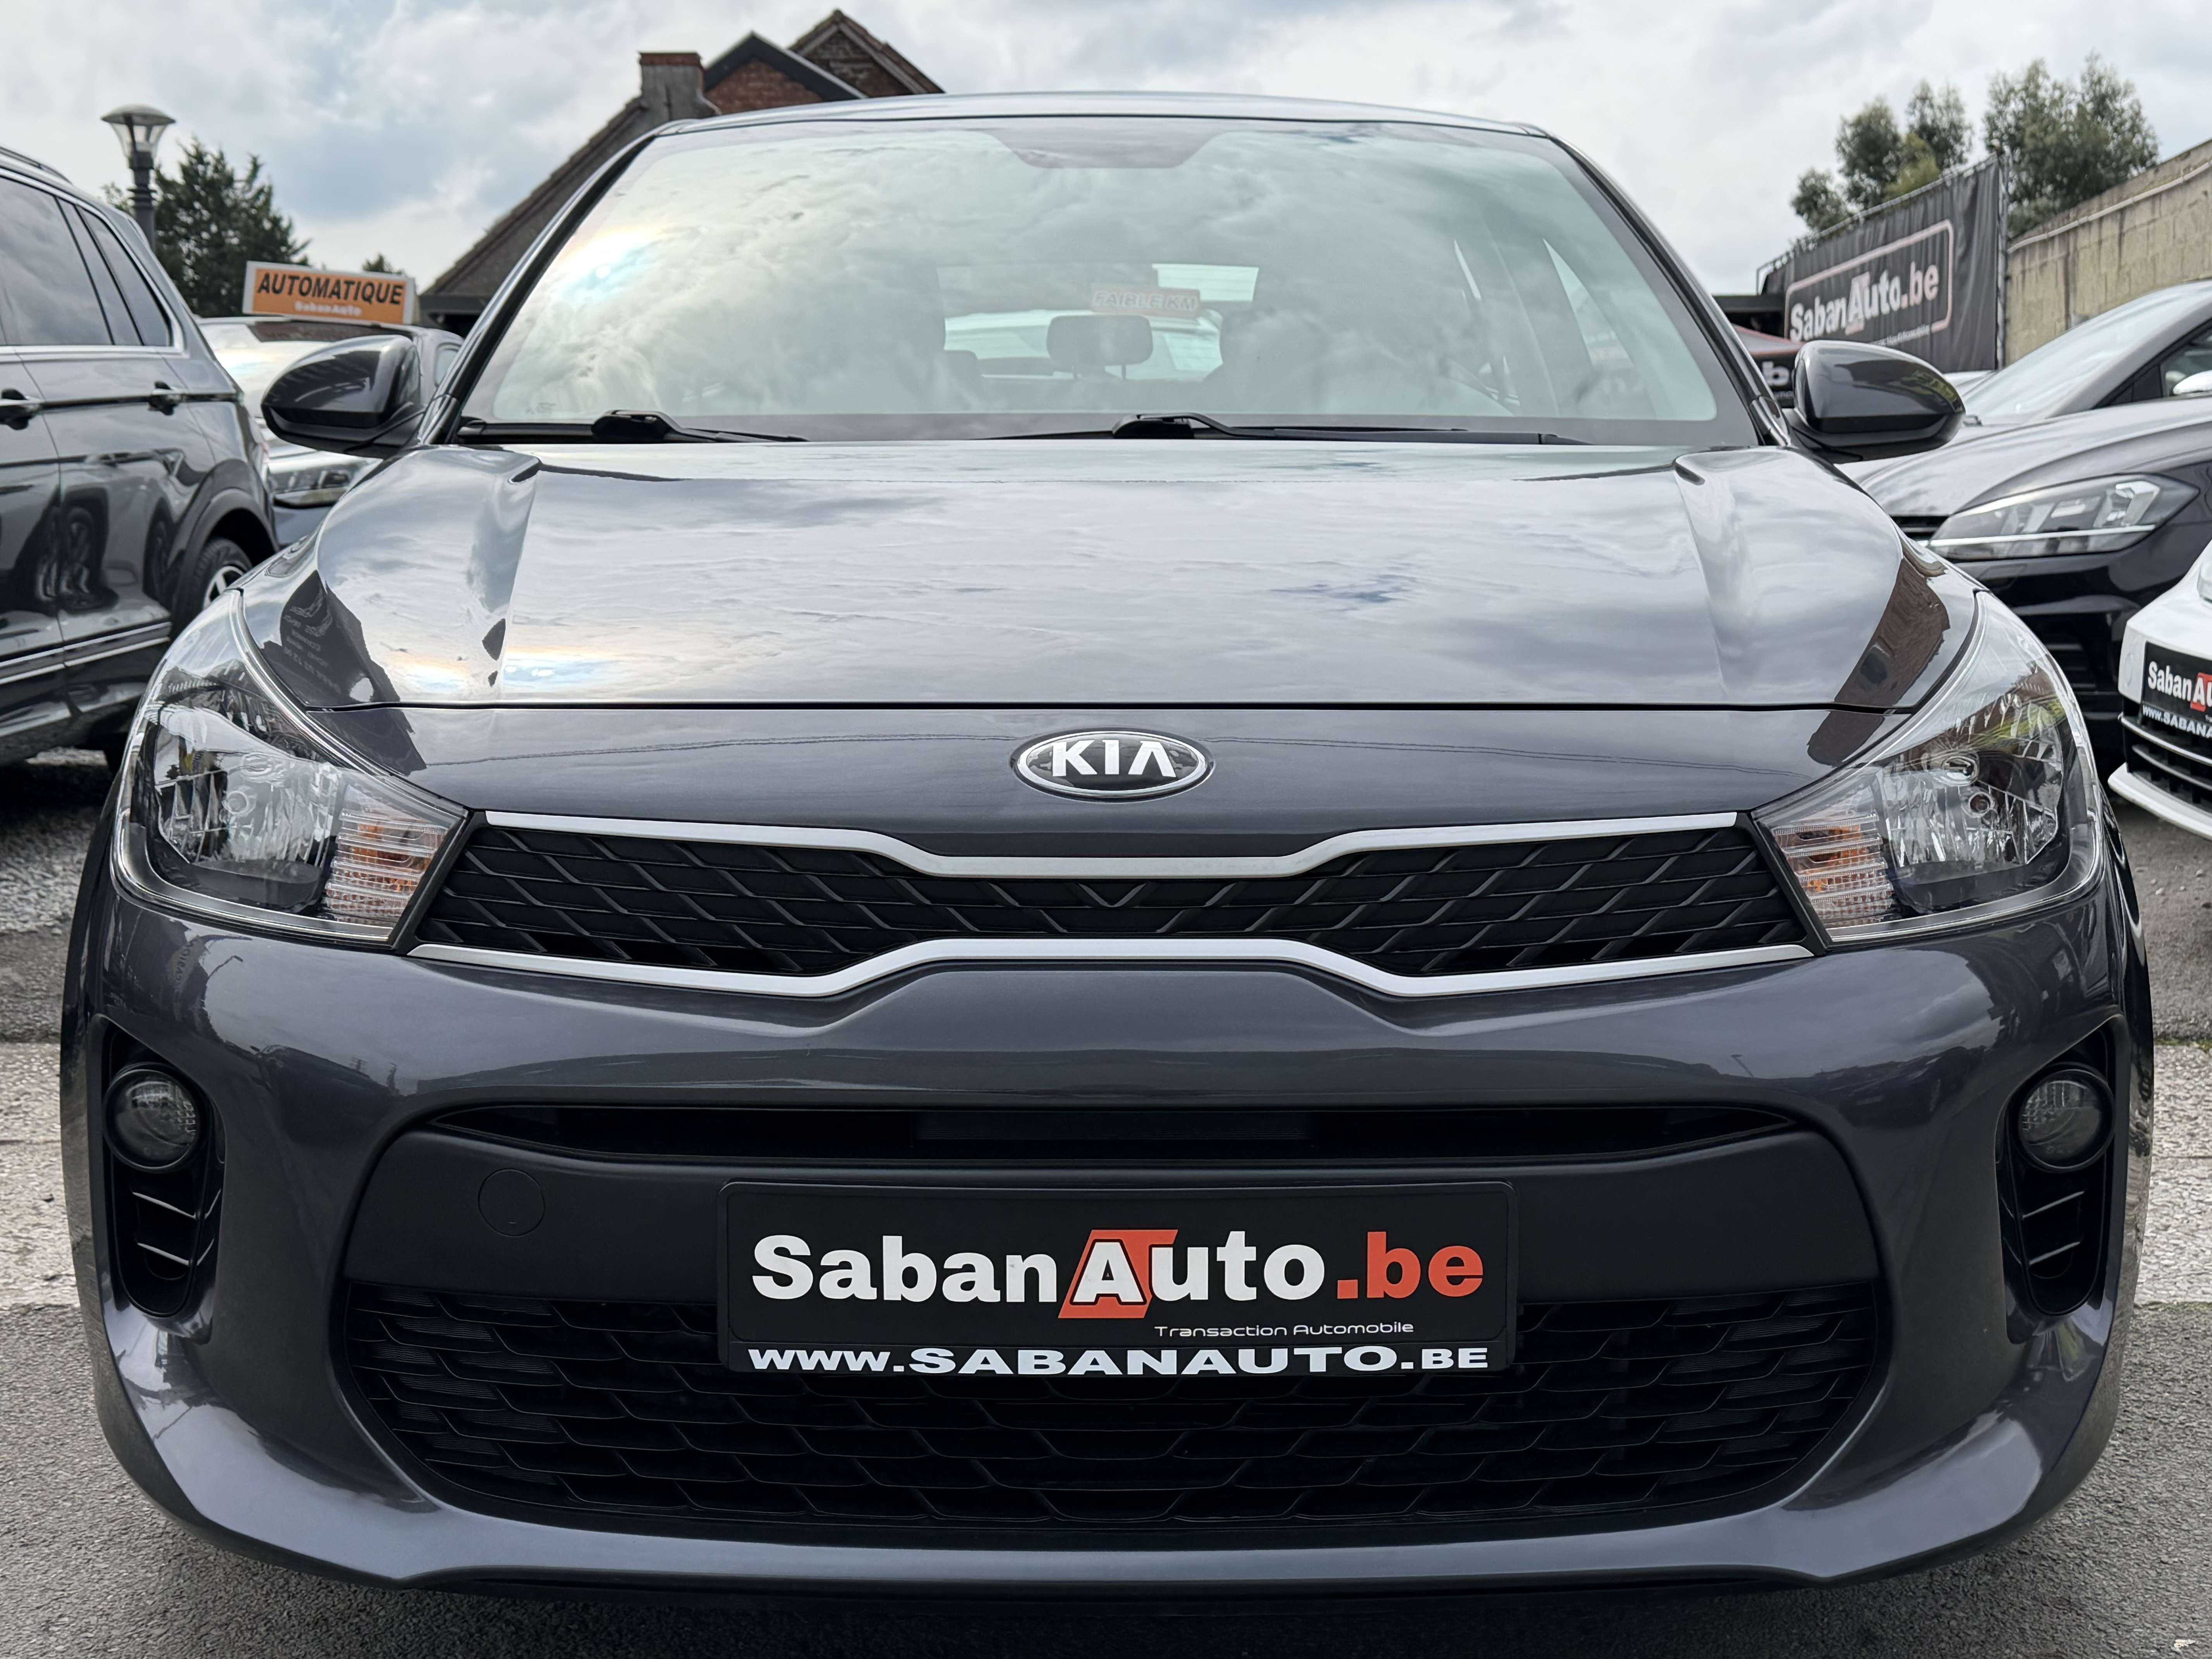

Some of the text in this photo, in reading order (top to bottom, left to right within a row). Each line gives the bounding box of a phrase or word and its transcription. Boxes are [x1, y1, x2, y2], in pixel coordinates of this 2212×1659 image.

[257, 272, 404, 305] AUTOMATIQUE
[1093, 290, 1198, 310] FAIBLE KM
[1790, 261, 1939, 342] SabanAuto.be
[1052, 739, 1176, 778] KIA
[1154, 1322, 1414, 1337] Transaction Automobile
